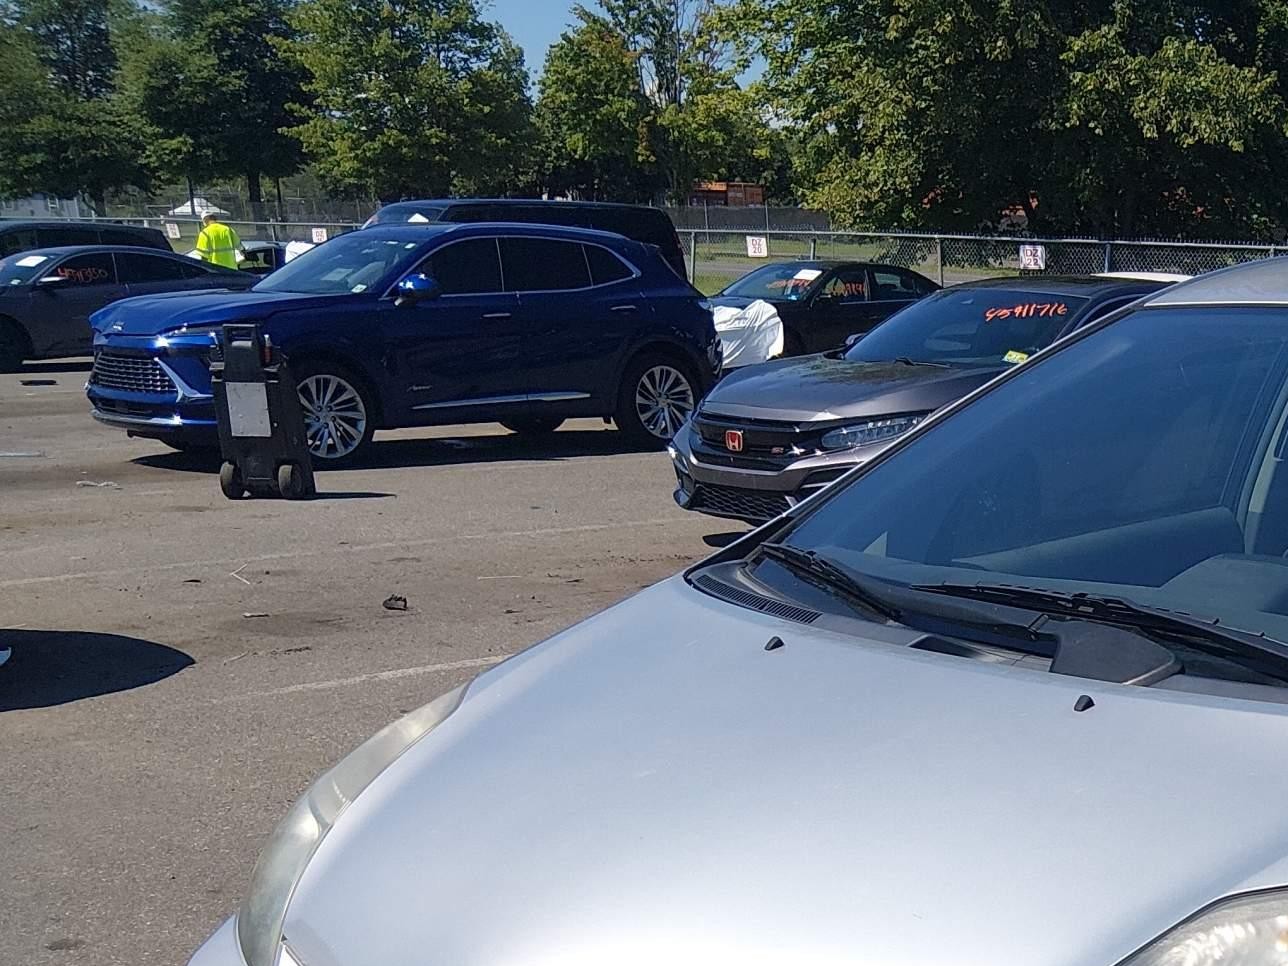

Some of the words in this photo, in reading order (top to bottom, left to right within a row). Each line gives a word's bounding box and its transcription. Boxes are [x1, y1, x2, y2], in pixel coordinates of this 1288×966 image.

[752, 239, 762, 247] DZ
[1025, 248, 1039, 258] DZ
[1027, 258, 1039, 267] 22
